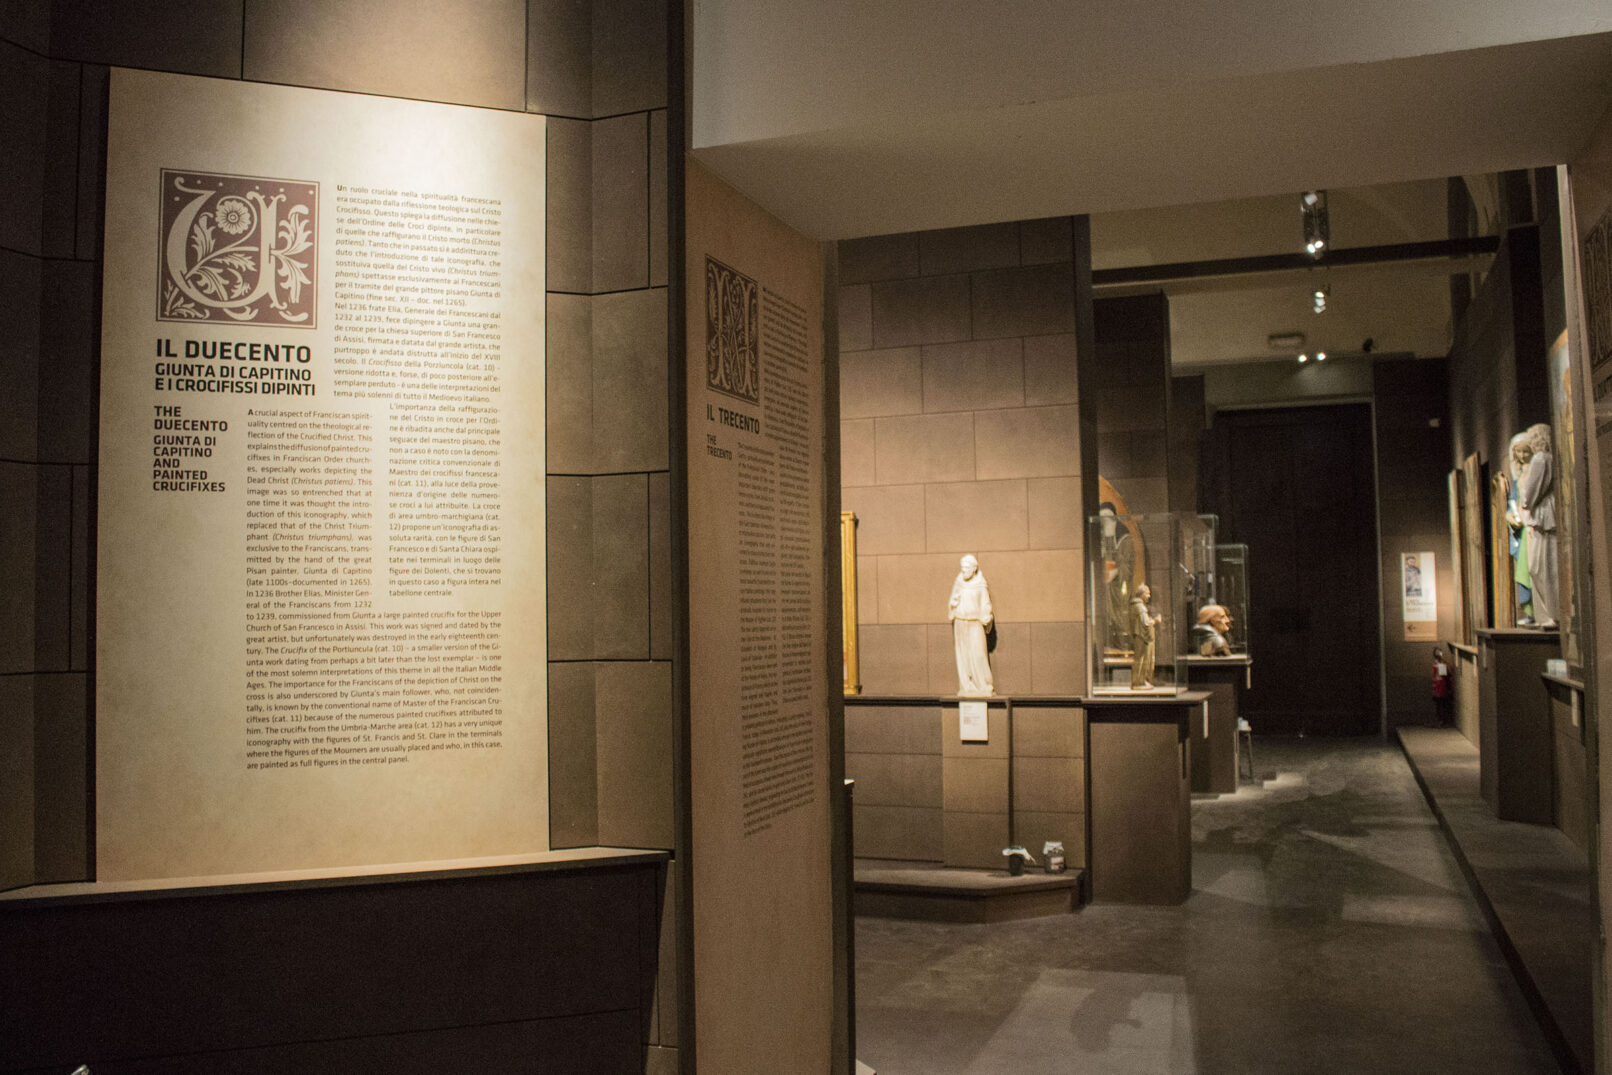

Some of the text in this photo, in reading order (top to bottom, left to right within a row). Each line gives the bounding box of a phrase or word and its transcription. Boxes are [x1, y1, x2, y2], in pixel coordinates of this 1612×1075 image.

[350, 185, 368, 193] ruolo
[371, 186, 397, 196] cruciale
[400, 189, 418, 197] nella
[420, 191, 458, 202] spiritualità
[461, 194, 501, 205] francescana
[374, 208, 398, 217] Questo
[400, 210, 422, 220] spiega
[431, 213, 465, 222] diffusione
[467, 216, 483, 224] nelle
[484, 217, 501, 225] chie-
[354, 281, 381, 290] tramite
[395, 284, 419, 294] grande
[420, 286, 444, 295] pittore
[446, 287, 468, 297] pisano
[470, 289, 492, 297] Giunta
[156, 338, 310, 363] IL DUECENTO
[334, 345, 369, 355] purtroppo
[379, 347, 404, 355] andata
[406, 349, 437, 357] distrutta
[155, 362, 311, 381] GIUNTA DI CAPITINO
[154, 377, 315, 396] E I CROCIFISSI DIPINTI
[153, 406, 181, 417] THE
[279, 409, 302, 418] aspect
[312, 410, 350, 418] Franciscan
[351, 412, 373, 421] spirit-
[154, 419, 228, 431] DUECENTO
[706, 404, 760, 434] IL TRECENTO
[153, 434, 216, 445] GIUNTA DI
[706, 434, 716, 445] THE
[153, 446, 212, 457] CAPITINO
[706, 446, 732, 460] TRECENTO
[153, 458, 179, 467] AND
[153, 469, 207, 479] PAINTED
[152, 481, 225, 491] CRUCIFIXES
[246, 532, 268, 541] phant
[272, 533, 303, 541] (Christus
[275, 555, 284, 564] by
[353, 556, 372, 564] great
[389, 567, 409, 575] figure
[397, 578, 422, 586] questo
[446, 578, 467, 586] figura
[383, 611, 400, 619] large
[402, 611, 429, 619] painted
[480, 610, 501, 618] Upper
[280, 725, 306, 733] crucifix
[431, 720, 442, 729] 12)
[479, 718, 502, 727] unique
[246, 749, 269, 757] where
[284, 748, 309, 757] figures
[333, 745, 367, 754] Mourners
[381, 744, 406, 753] usually
[407, 743, 430, 752] placed
[260, 760, 288, 770] painted
[313, 758, 338, 767] figures
[362, 756, 386, 764] central
